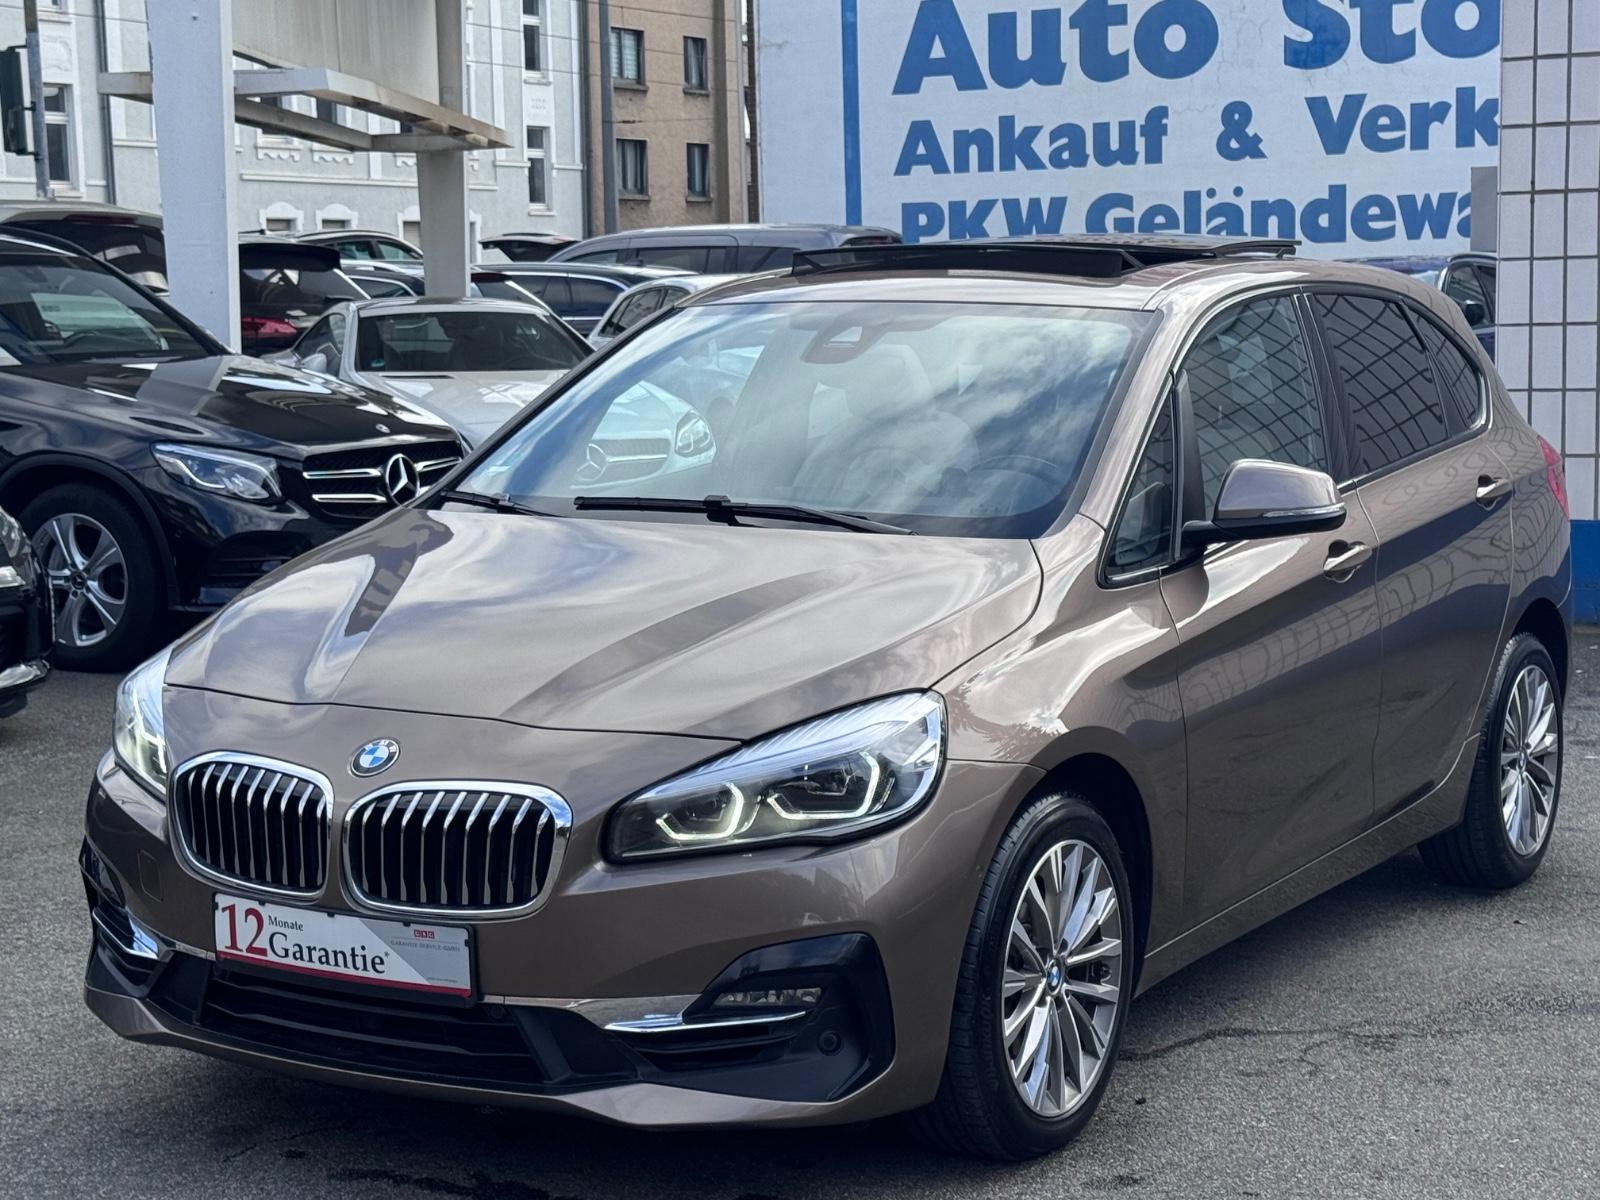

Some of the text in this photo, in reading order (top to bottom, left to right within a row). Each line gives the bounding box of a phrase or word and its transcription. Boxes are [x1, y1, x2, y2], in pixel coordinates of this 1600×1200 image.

[892, 0, 1219, 95] Auto
[894, 86, 1499, 177] Ankauf & Verk
[901, 196, 1067, 245] PKW
[221, 903, 268, 957] 12
[268, 915, 304, 932] Monate
